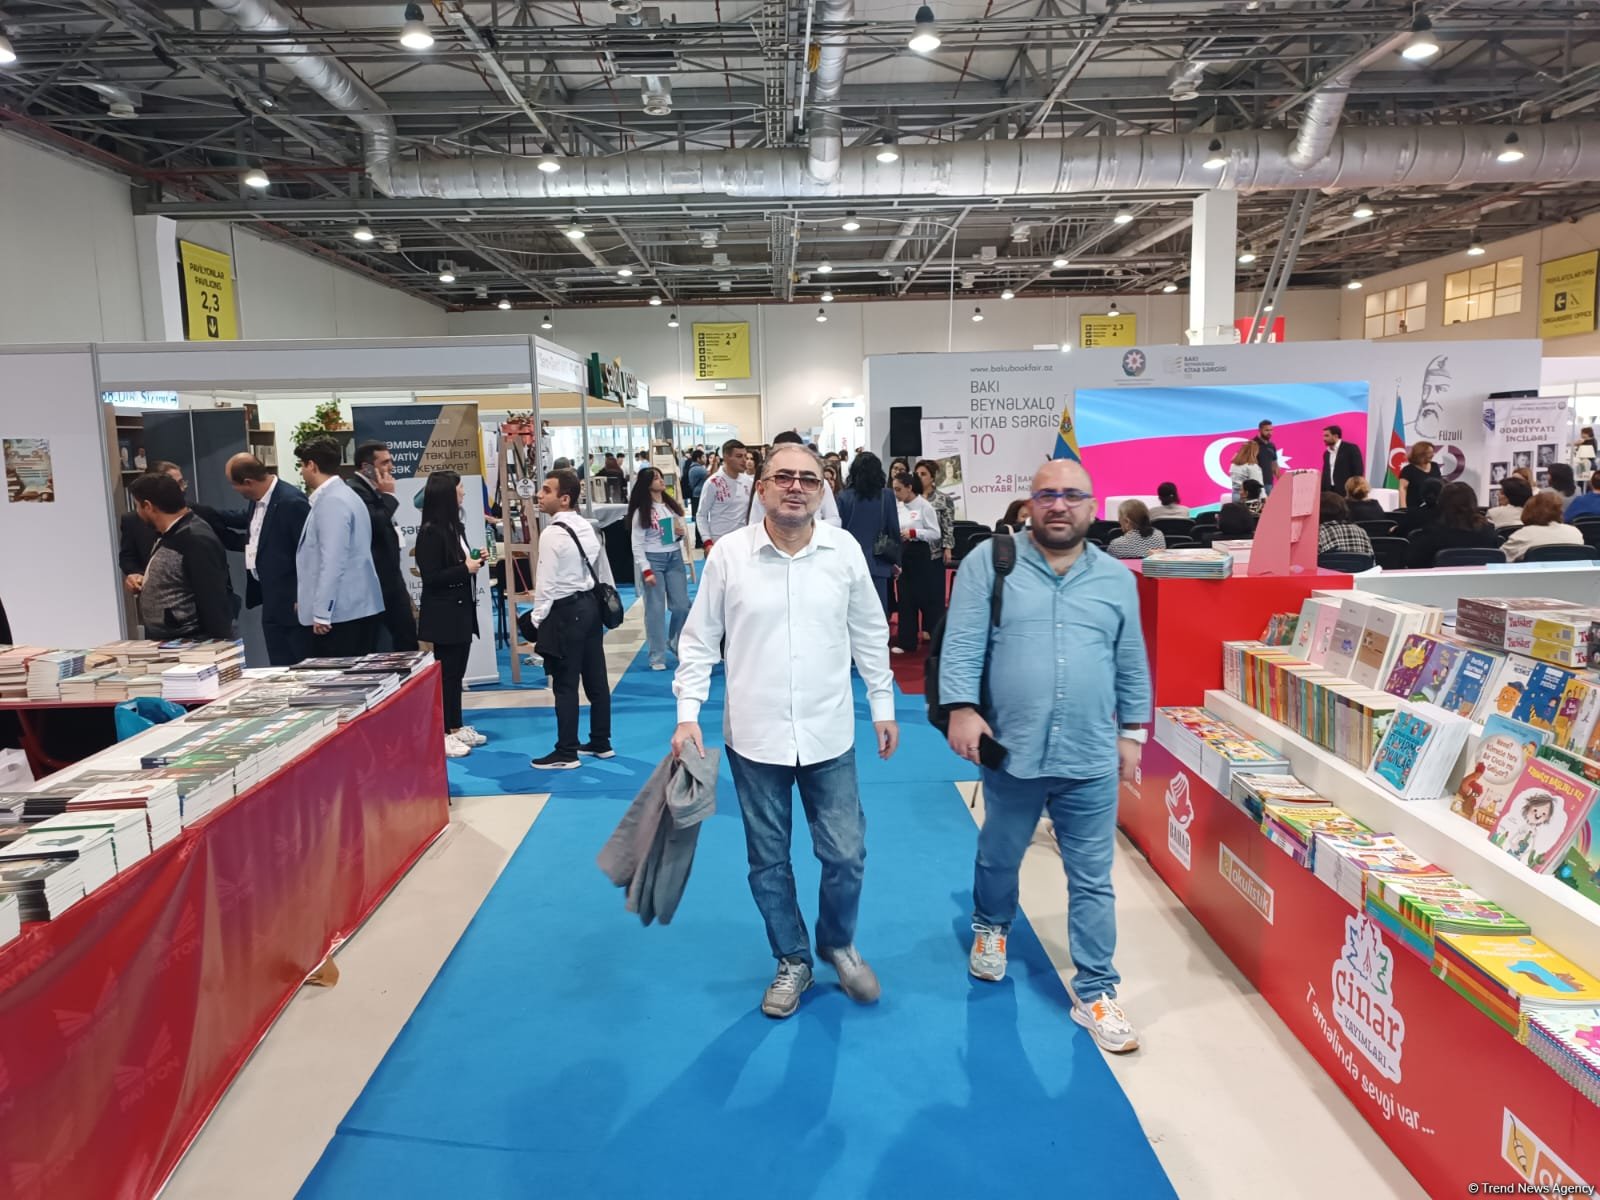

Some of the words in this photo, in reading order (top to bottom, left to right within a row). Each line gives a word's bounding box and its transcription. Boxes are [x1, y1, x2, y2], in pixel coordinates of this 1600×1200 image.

[200, 290, 220, 312] 2,3
[970, 364, 1054, 373] www.bakubookfair.az
[970, 380, 1000, 394] BAKI
[970, 397, 1055, 412] BEYNƏLXALQ
[970, 412, 1008, 429] KİTAB
[1011, 414, 1060, 428] SƏRGİS
[1511, 416, 1542, 425] DÜNYA
[1499, 425, 1555, 434] ƏDƏBİYYATI
[1506, 434, 1548, 442] İNCİLƏRİ
[386, 440, 426, 450] ƏMMƏL
[970, 433, 995, 456] 10
[391, 453, 419, 462] VATİV
[995, 474, 1013, 484] 2-8
[970, 485, 1013, 494] OKTYABR
[1232, 867, 1269, 915] okulistik
[1335, 968, 1400, 1053] Çinar
[1361, 1074, 1394, 1121] sevgi
